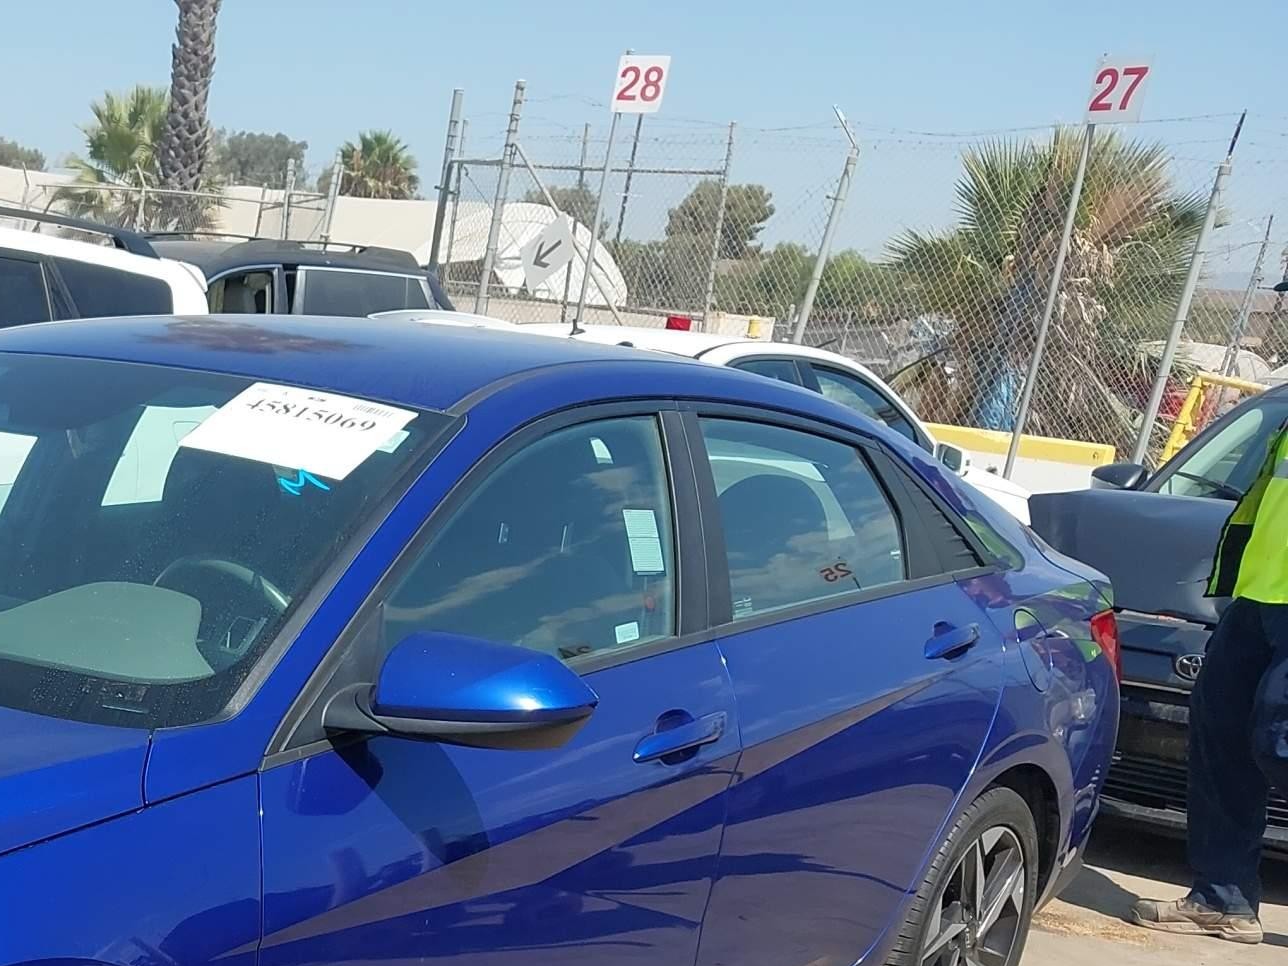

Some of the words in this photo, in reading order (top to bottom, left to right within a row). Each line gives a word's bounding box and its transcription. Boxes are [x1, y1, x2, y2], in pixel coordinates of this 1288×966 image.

[616, 66, 663, 101] 28
[1089, 66, 1149, 111] 27
[246, 398, 377, 432] 45815069
